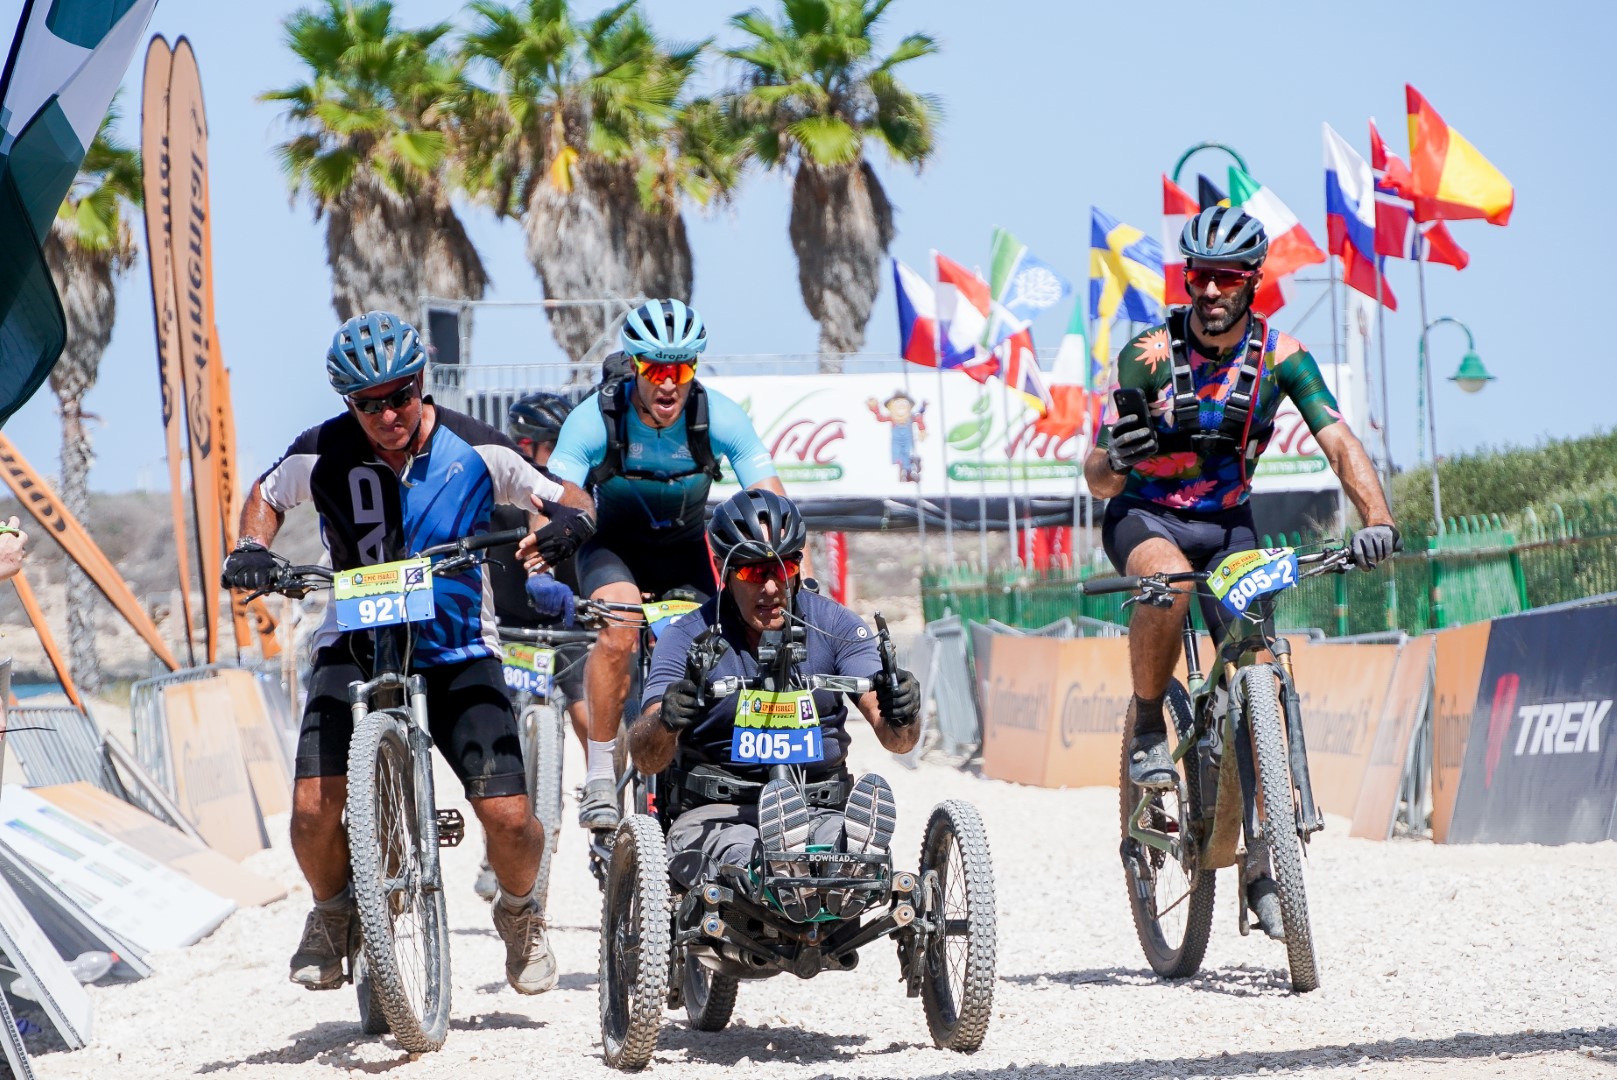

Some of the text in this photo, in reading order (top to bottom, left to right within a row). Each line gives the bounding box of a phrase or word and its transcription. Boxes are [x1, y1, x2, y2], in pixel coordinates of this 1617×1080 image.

[655, 351, 689, 361] drops
[1229, 559, 1294, 611] 805-2
[358, 595, 408, 624] 921
[503, 666, 547, 693] 801-2
[775, 704, 795, 712] ISRAEL
[1514, 699, 1614, 756] TREK
[738, 730, 815, 760] 805-1
[809, 854, 851, 863] BOWHEAD
